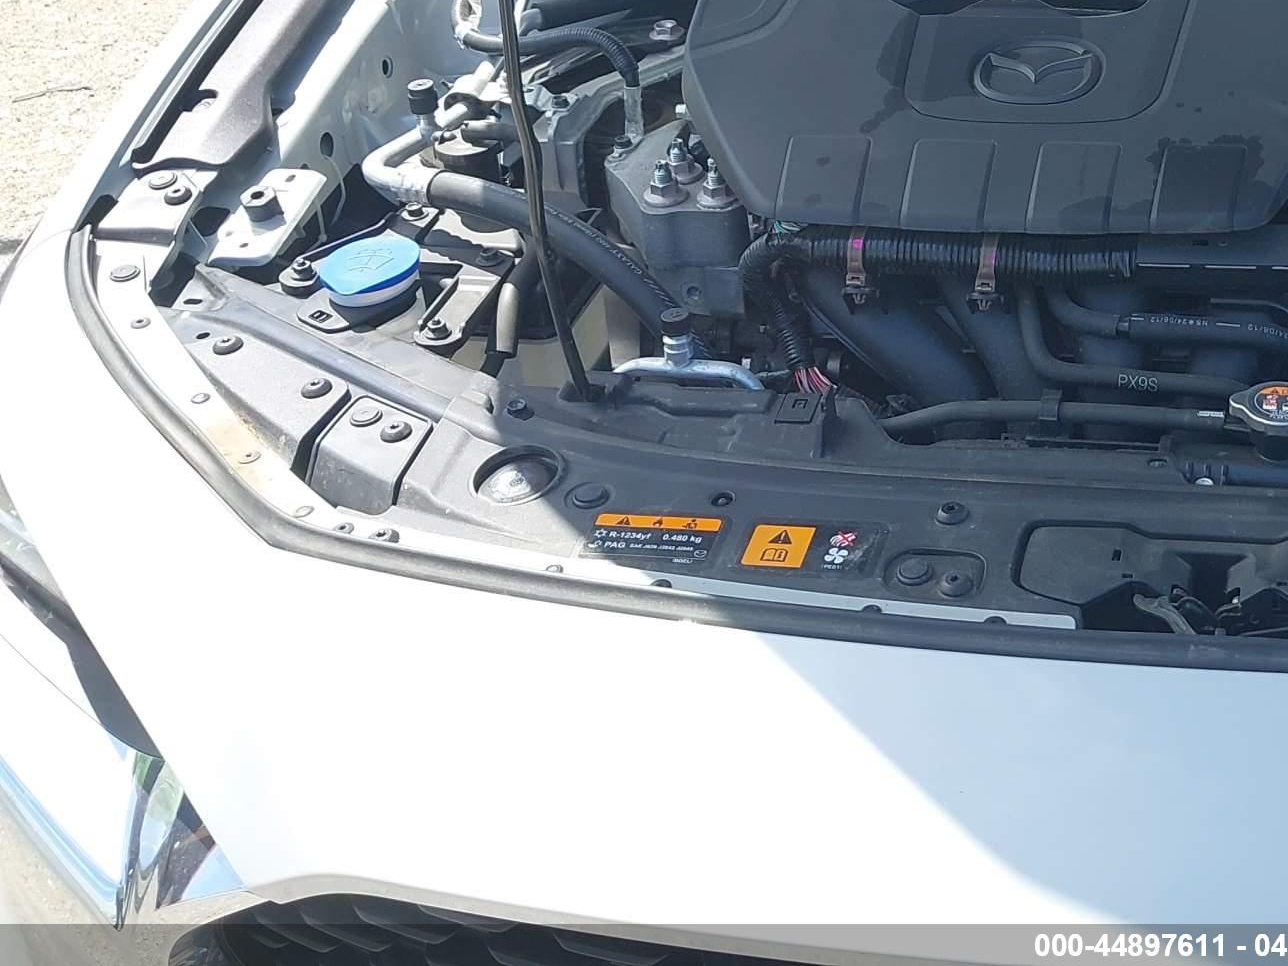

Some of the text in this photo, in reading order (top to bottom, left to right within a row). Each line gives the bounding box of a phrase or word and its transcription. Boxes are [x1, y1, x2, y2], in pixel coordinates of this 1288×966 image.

[1117, 374, 1159, 393] PX9S
[609, 530, 652, 541] R-1234yf
[689, 535, 703, 544] kg
[604, 541, 626, 549] PAG
